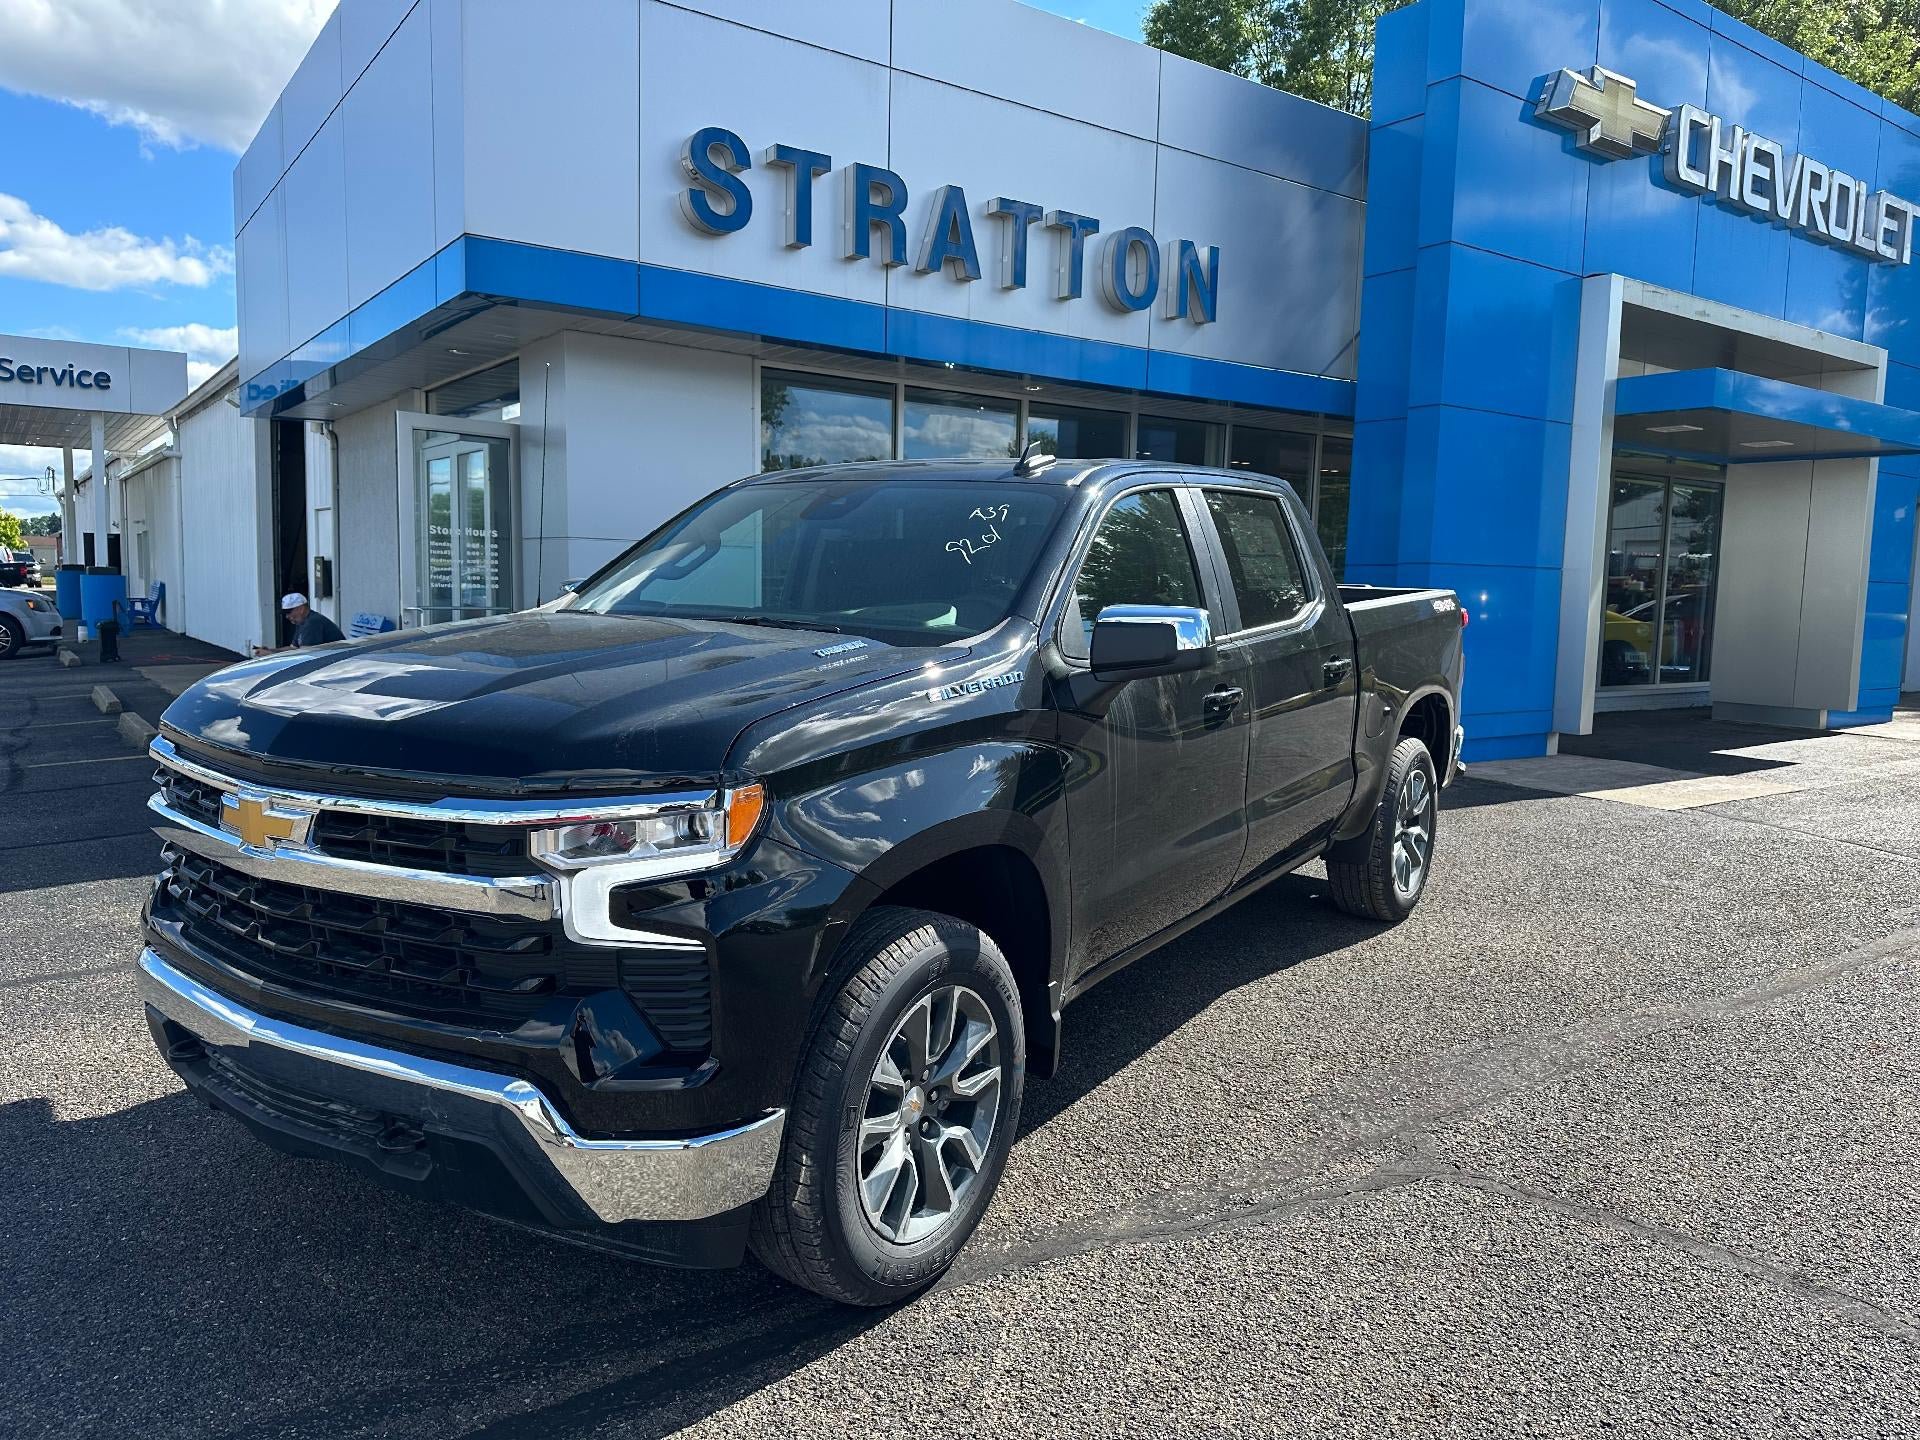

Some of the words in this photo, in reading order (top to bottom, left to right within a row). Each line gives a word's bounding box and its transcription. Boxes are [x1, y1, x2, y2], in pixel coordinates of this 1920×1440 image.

[679, 126, 1220, 325] STRATTON
[1670, 103, 1920, 265] CHEVROLET
[0, 357, 112, 391] Service
